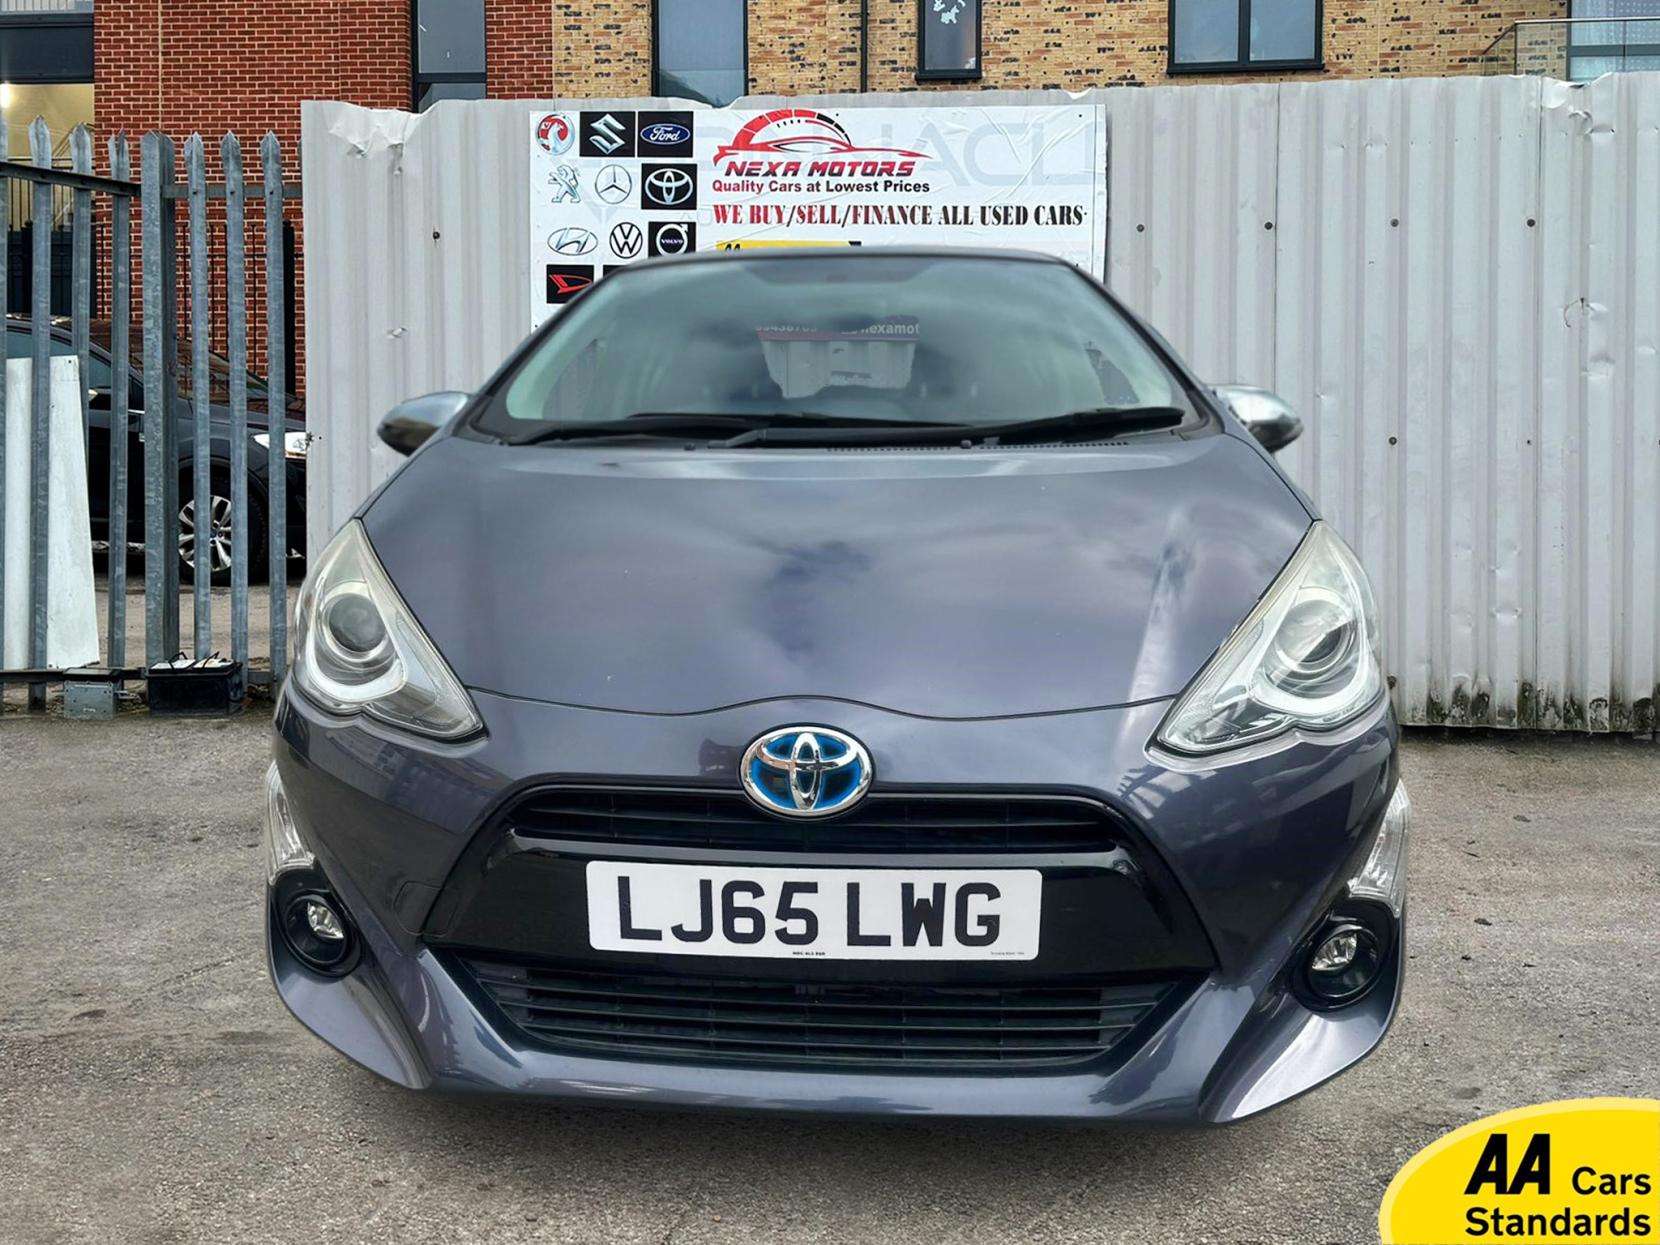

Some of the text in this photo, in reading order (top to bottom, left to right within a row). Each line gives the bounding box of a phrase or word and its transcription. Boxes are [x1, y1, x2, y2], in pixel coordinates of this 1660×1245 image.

[650, 125, 680, 141] Ford
[724, 161, 915, 177] NEXA MOTORS
[712, 179, 930, 195] Quality Cars at Lowest Prices
[713, 204, 1083, 227] WE BUY/SELL/FINANCE ALL USED CARS
[617, 875, 1001, 948] LJ65 LWG
